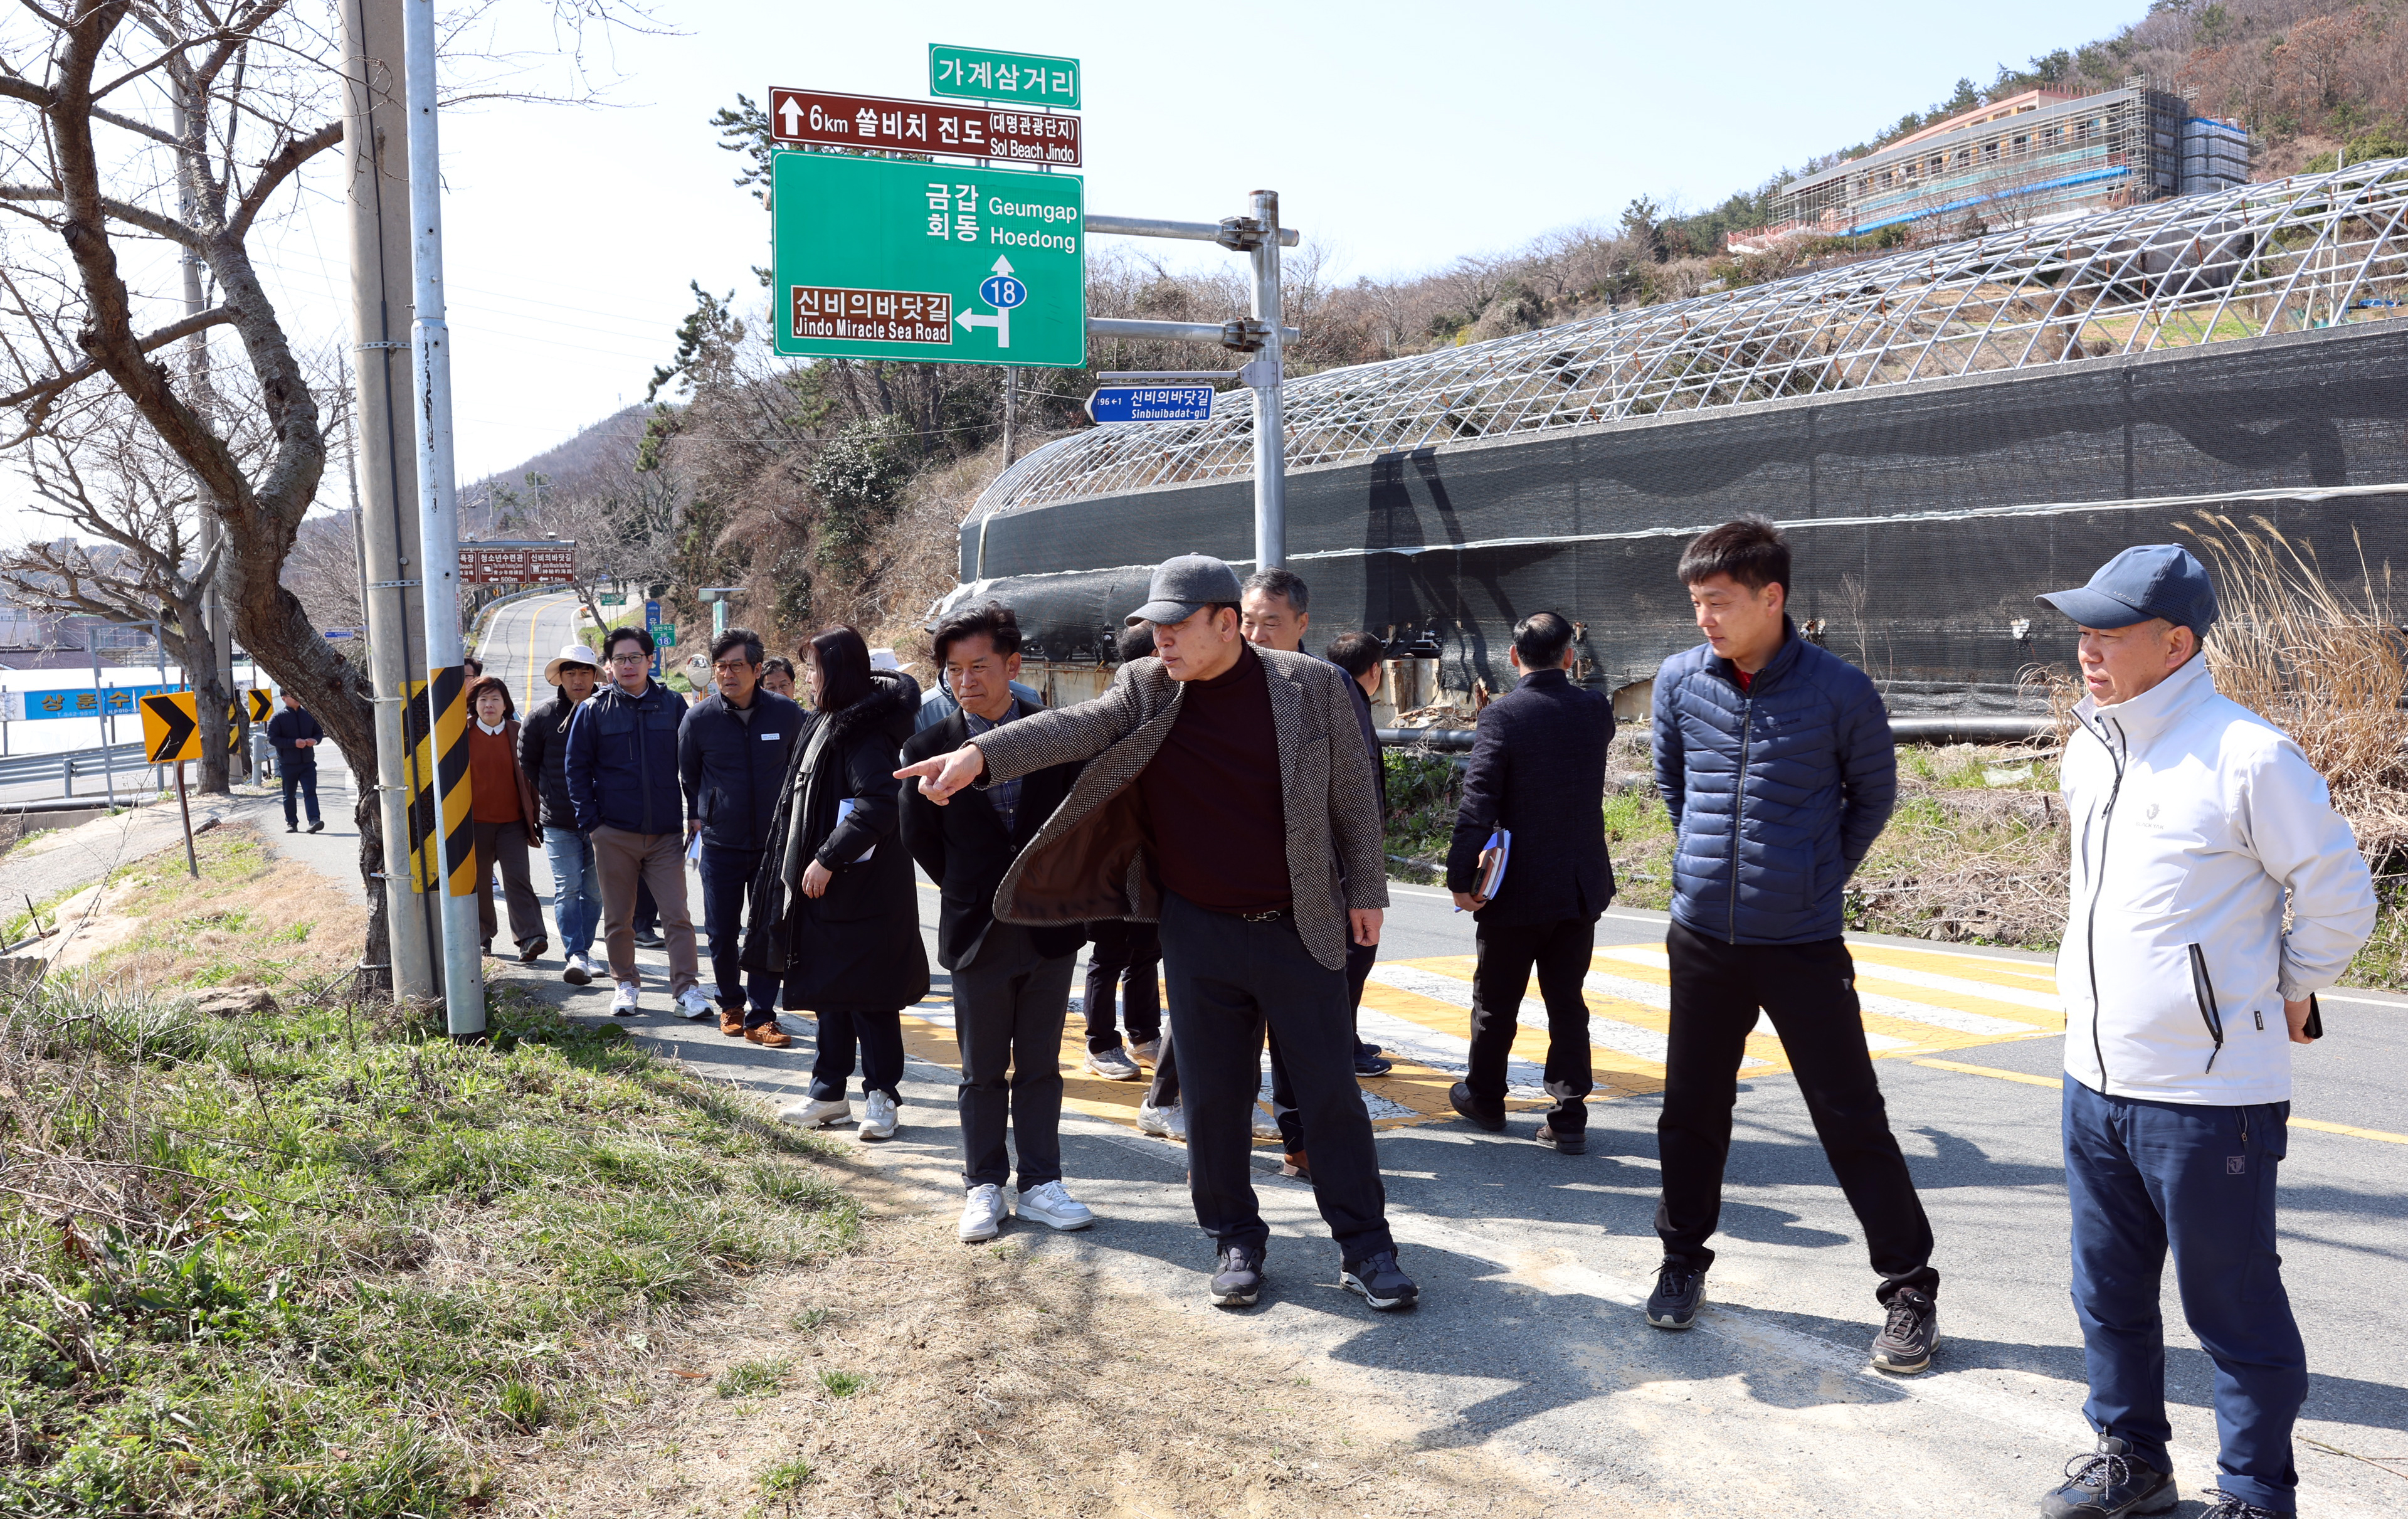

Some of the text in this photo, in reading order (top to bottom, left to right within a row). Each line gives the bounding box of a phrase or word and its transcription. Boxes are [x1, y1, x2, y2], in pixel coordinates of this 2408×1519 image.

[938, 58, 1074, 97] 가계삼거리
[810, 105, 985, 144] 6km 쏠비치 진도
[990, 113, 1074, 141] (대명관광단지)
[990, 137, 1074, 162] Sol Beach Jindo
[926, 183, 979, 212] 금갑
[989, 197, 1077, 224] Geumgap
[927, 213, 980, 242] 회동
[991, 226, 1075, 254] Hoedong
[991, 280, 1016, 304] 18
[796, 290, 947, 322] 신비의바닷길
[796, 317, 947, 341] Jindo Miracle Sea Road
[1131, 390, 1209, 406] 신비의바닷길
[1131, 408, 1207, 420] Sinbiuibadat-gil
[460, 554, 474, 563] 욕장
[481, 554, 523, 563] 청소년수련관
[531, 553, 572, 562] 신비의바닷길
[658, 637, 669, 645] 18
